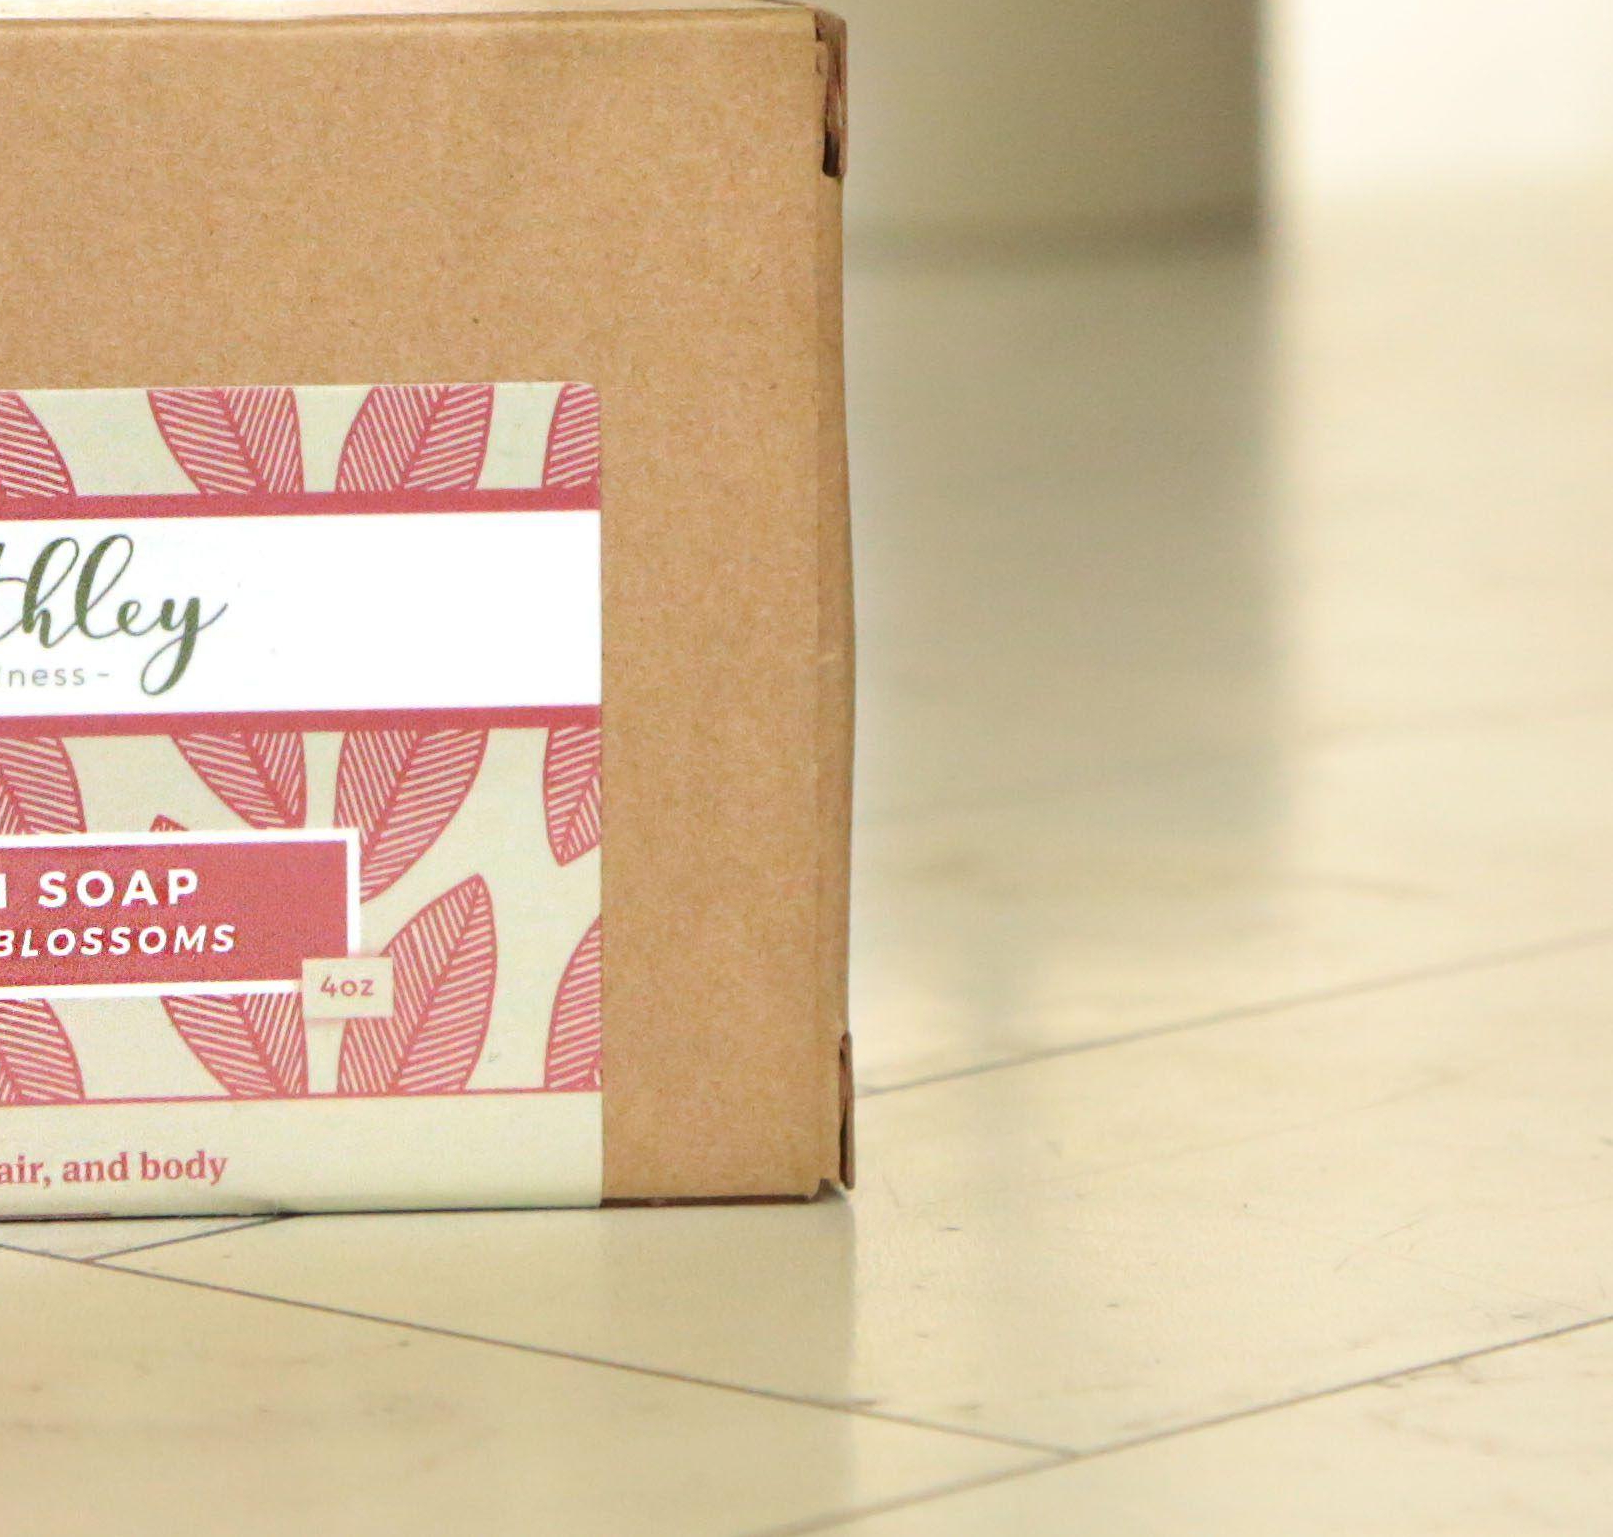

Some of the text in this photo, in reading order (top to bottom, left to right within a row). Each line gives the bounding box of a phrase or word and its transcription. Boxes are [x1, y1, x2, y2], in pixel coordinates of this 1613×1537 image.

[36, 868, 200, 909] SOAP
[319, 975, 375, 999] 4oz
[62, 1151, 131, 1184] and
[138, 1149, 228, 1188] body
